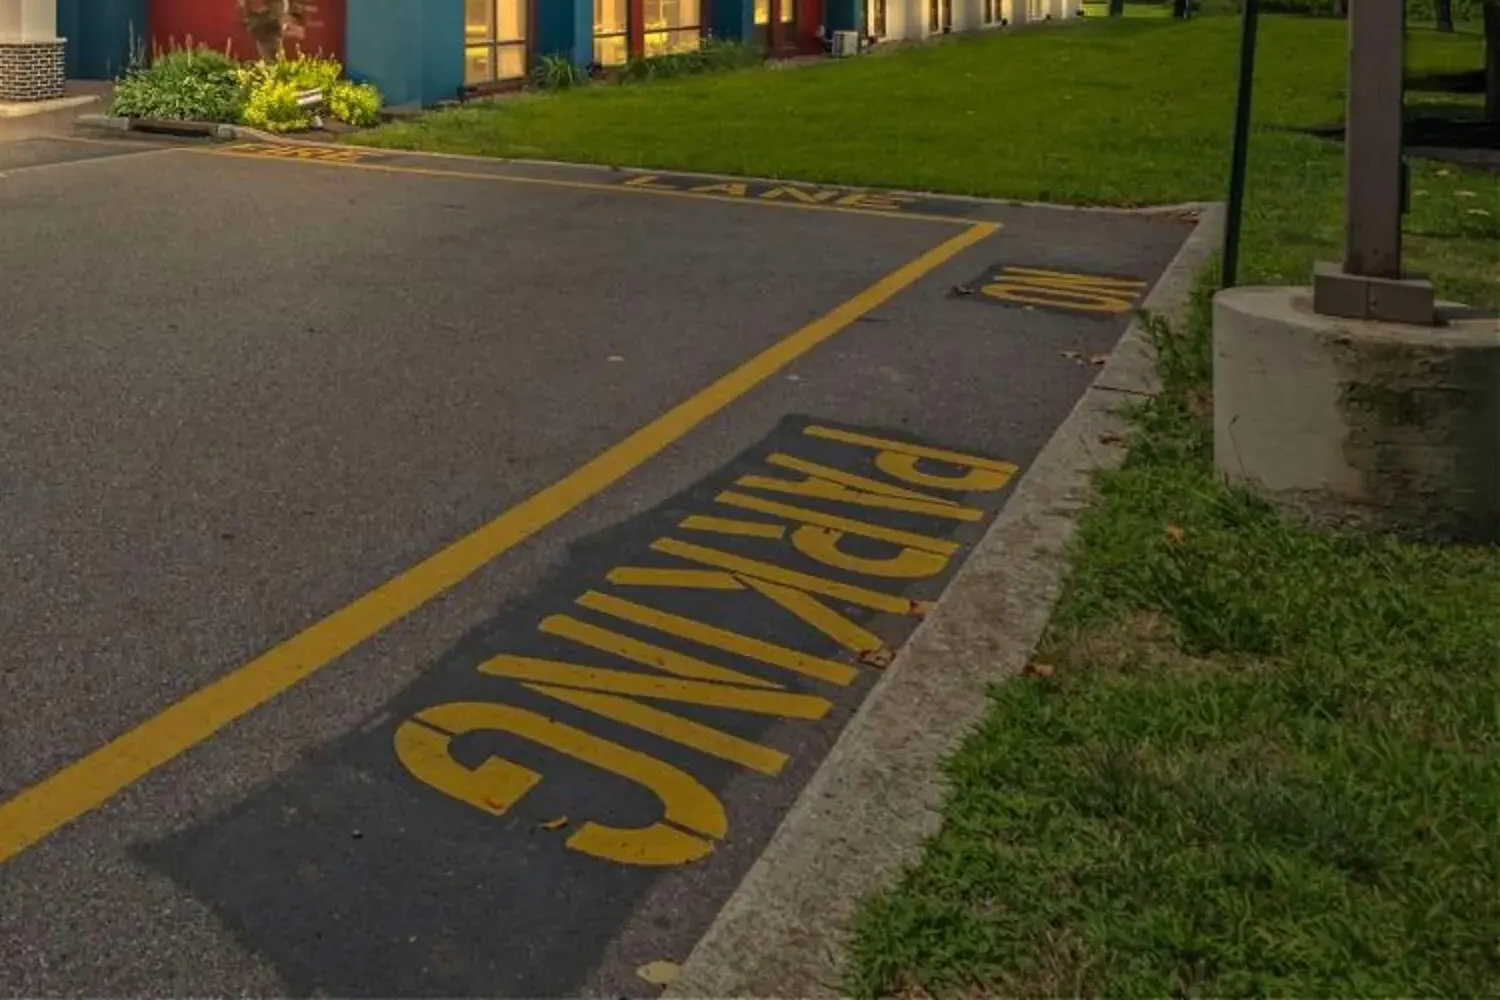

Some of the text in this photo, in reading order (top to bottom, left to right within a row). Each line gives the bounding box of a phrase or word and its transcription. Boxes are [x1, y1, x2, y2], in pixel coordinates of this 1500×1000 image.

[622, 174, 917, 211] LANE
[393, 266, 1148, 867] NO PARKING
